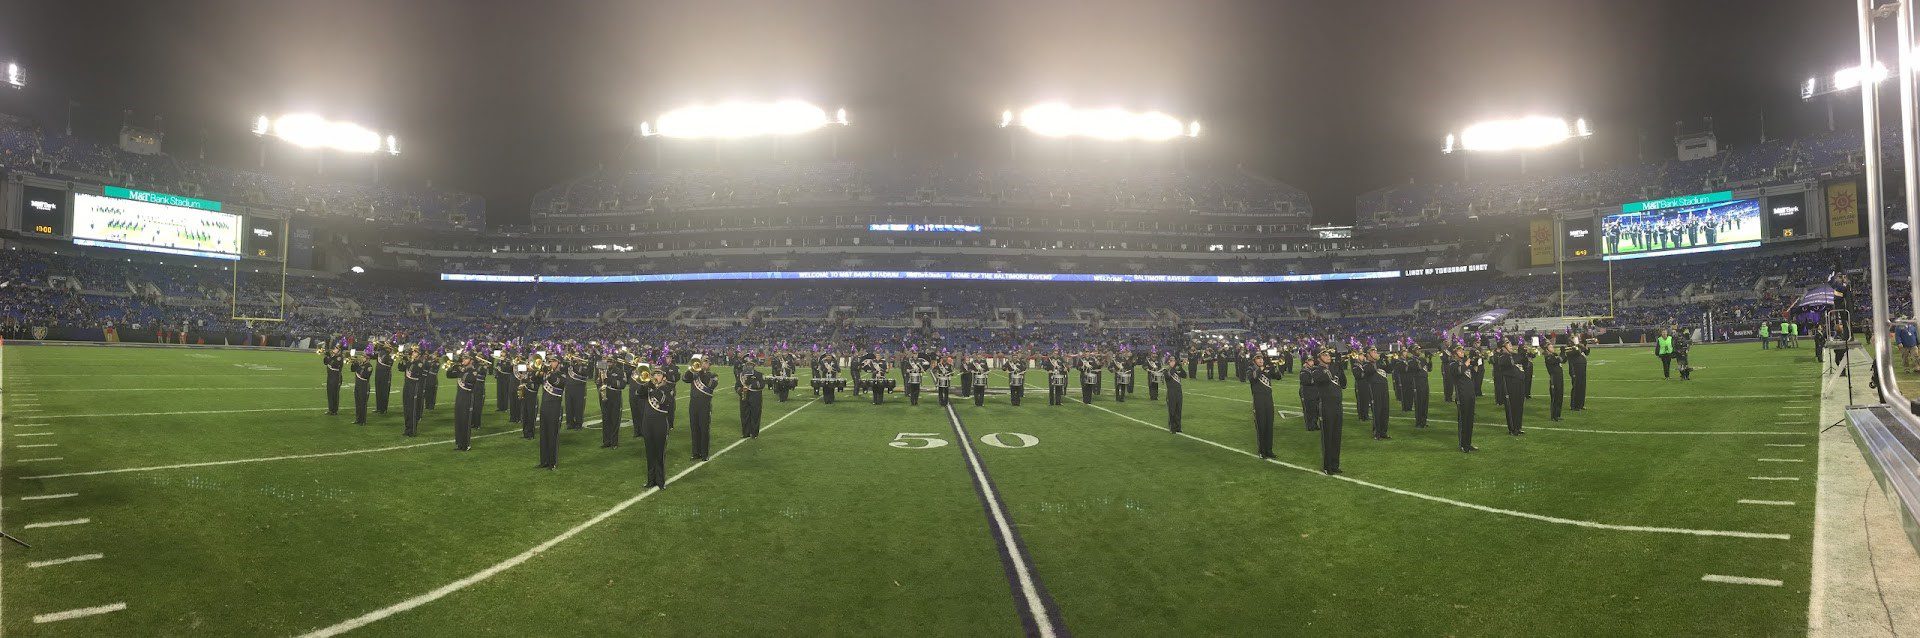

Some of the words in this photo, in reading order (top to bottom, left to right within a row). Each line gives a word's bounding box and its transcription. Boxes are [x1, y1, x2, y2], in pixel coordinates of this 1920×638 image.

[129, 190, 150, 202] M&T
[150, 193, 170, 205] Bank
[170, 196, 201, 208] Stadium
[1642, 200, 1661, 210] M&T
[1661, 198, 1678, 209] Bank
[1679, 196, 1709, 207] Stadium
[831, 271, 838, 279] TO
[981, 272, 993, 280] THE
[993, 272, 1028, 280] BALTIMORE
[1028, 273, 1052, 281] RAVENS
[1133, 274, 1166, 283] BALTIMORE
[1167, 275, 1190, 283] RAVENS
